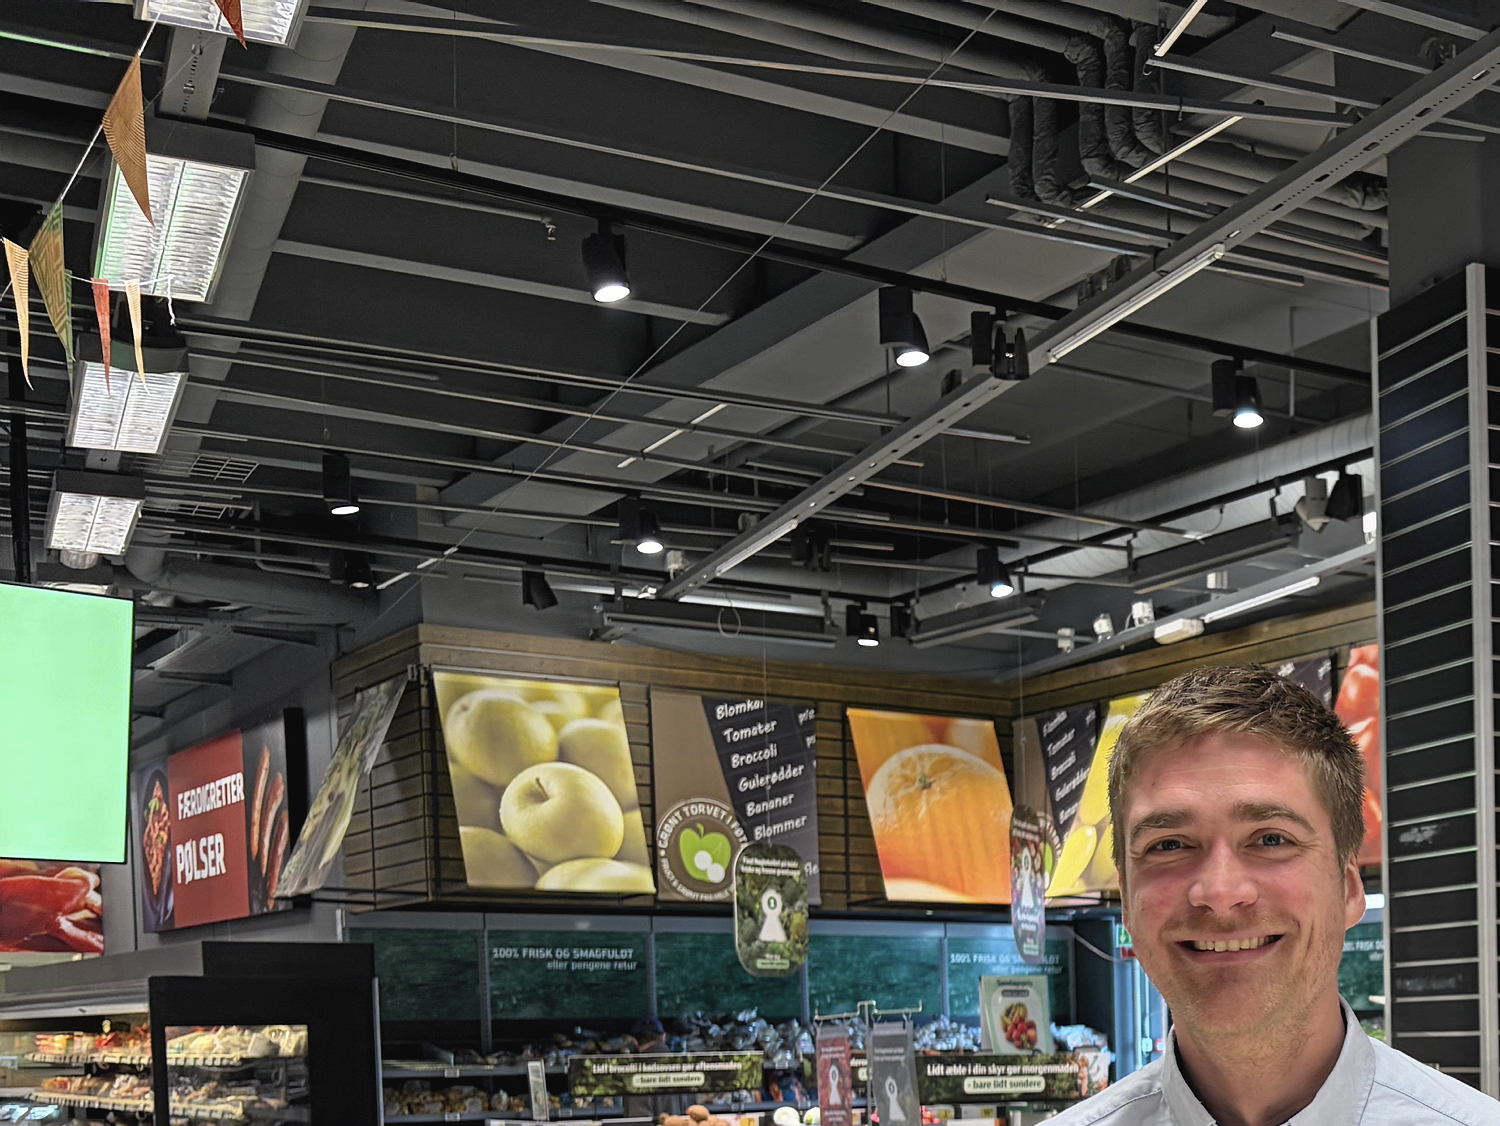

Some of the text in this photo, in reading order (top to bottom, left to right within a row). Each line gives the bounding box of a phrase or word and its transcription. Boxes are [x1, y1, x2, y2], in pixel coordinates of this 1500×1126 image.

[723, 720, 777, 743] Tomater
[730, 743, 778, 768] Broccoli
[738, 763, 805, 792] Gulerødder
[178, 772, 245, 820] FÆRDIGRETTER
[746, 792, 795, 817] Bananer
[682, 804, 727, 821] TORVET
[754, 815, 807, 841] Blommer
[176, 833, 226, 884] PØLSER
[493, 947, 634, 960] 100% FRISK OG SMAGFULDT
[547, 960, 637, 972] eller pengene retur
[593, 1063, 608, 1074] Lidt
[927, 1064, 945, 1076] Lidt
[973, 1063, 986, 1075] din
[988, 1063, 1005, 1076] skyr
[973, 1079, 991, 1089] bare
[993, 1079, 1007, 1089] lidt
[1009, 1079, 1041, 1089] sundere
